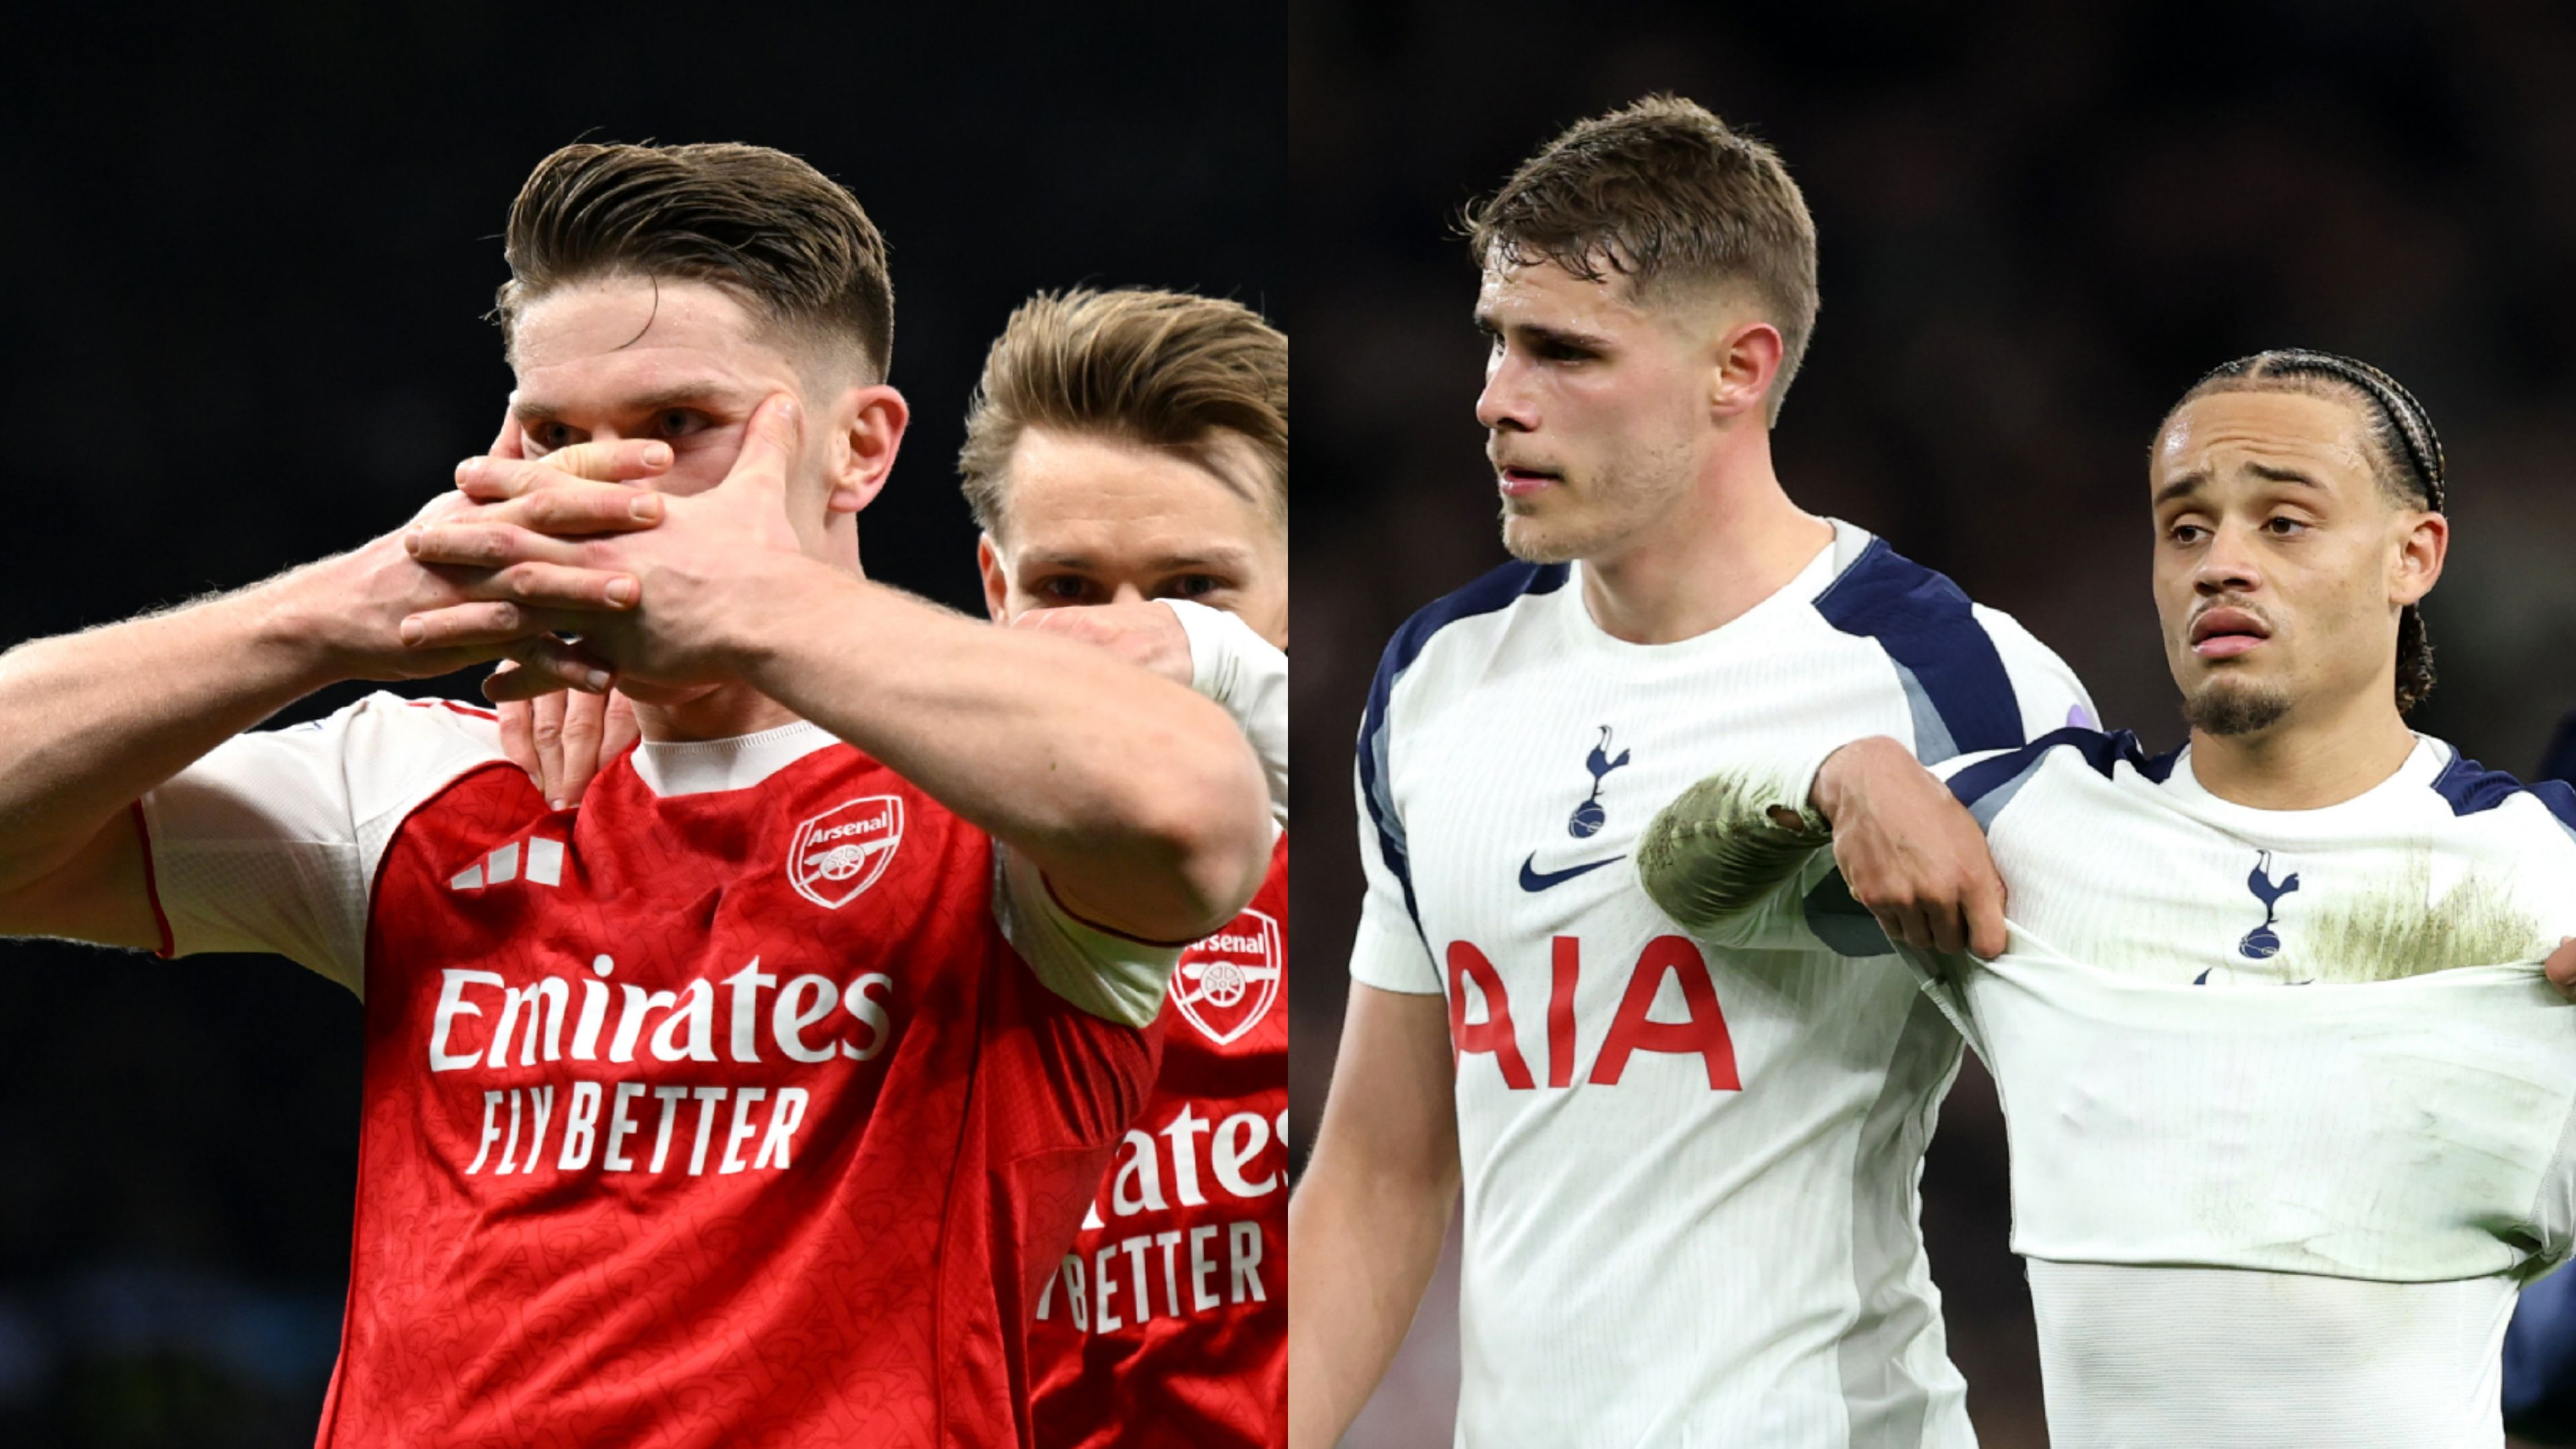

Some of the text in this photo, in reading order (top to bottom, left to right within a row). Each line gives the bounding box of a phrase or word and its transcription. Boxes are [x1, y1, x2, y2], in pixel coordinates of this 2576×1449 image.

[807, 810, 888, 847] Arsenal
[429, 954, 894, 1072] Emirates
[1447, 935, 1743, 1091] AIA
[464, 1081, 809, 1176] FLY BETTER
